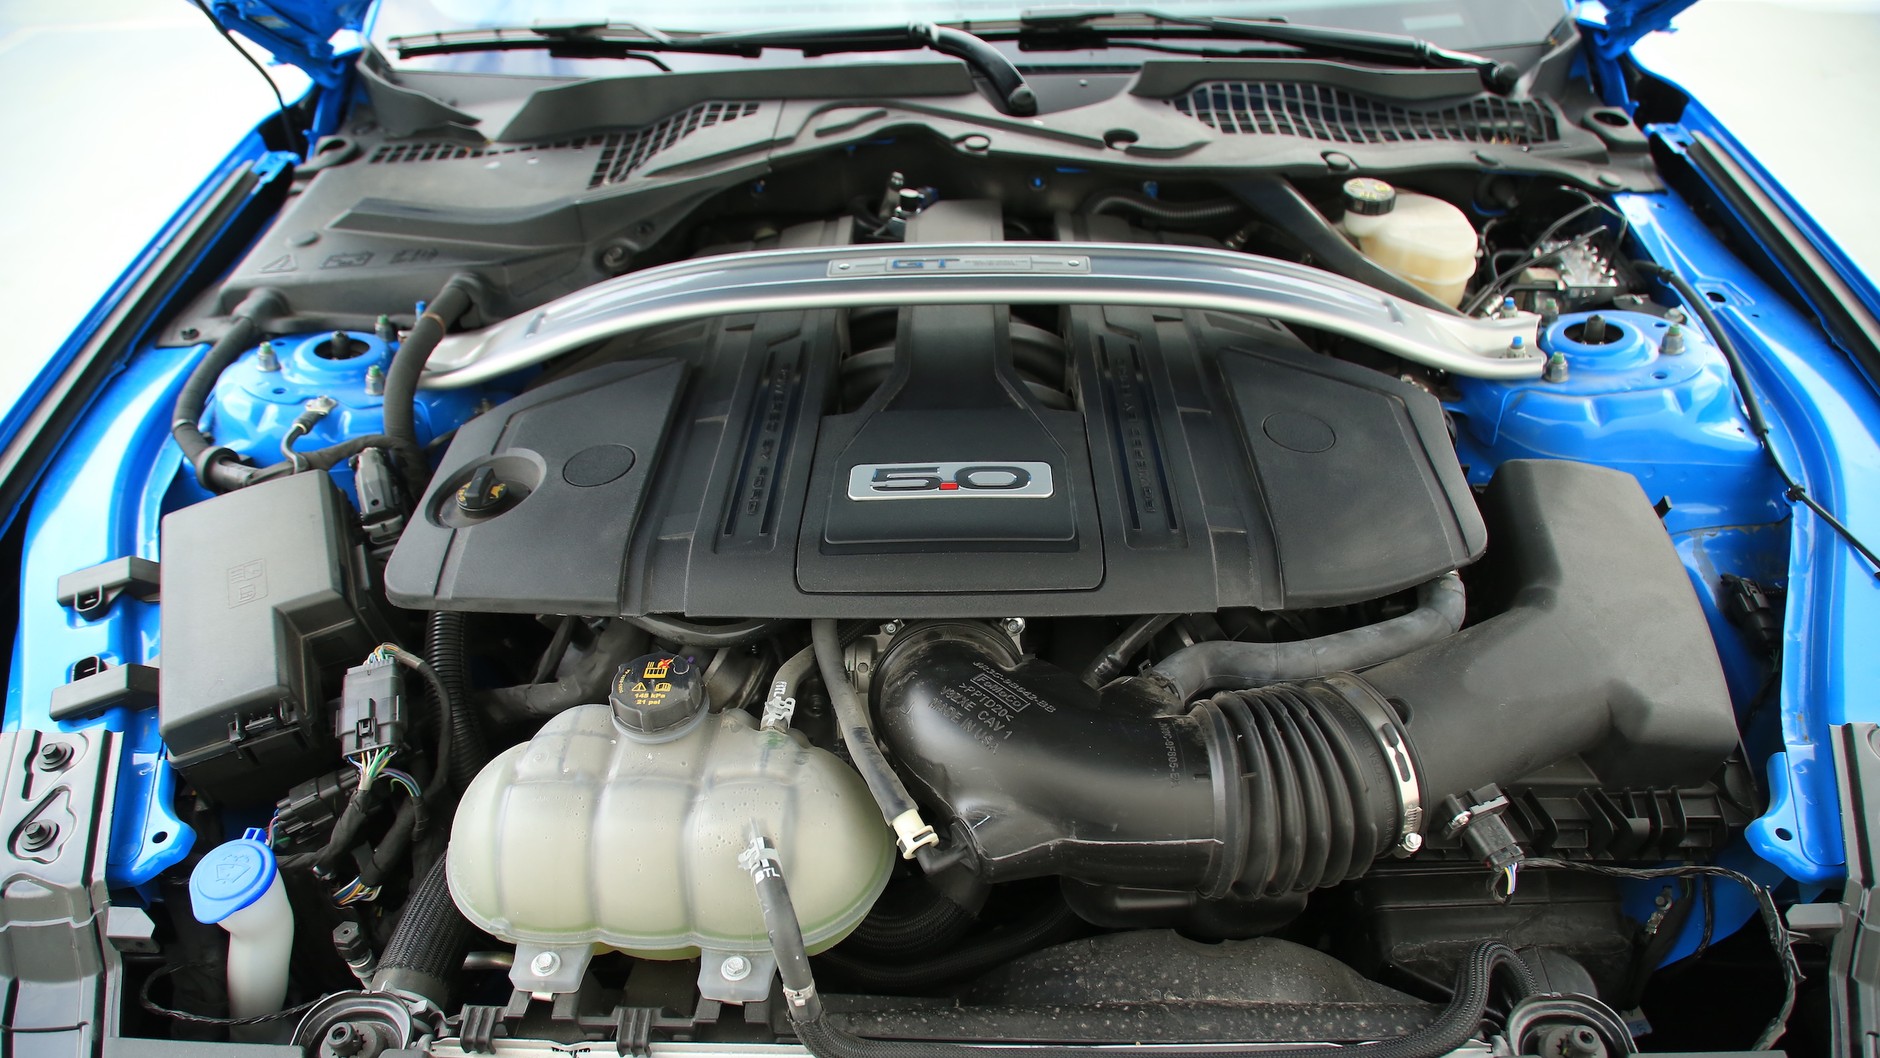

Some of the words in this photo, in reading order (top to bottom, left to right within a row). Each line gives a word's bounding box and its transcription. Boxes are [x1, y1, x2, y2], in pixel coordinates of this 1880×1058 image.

[891, 258, 960, 269] GT
[870, 465, 1032, 491] 5.0
[976, 676, 1021, 707] FoMoCo
[928, 698, 963, 723] MADE
[960, 718, 976, 732] IN
[977, 710, 1005, 731] CAV
[1004, 730, 1013, 740] 1
